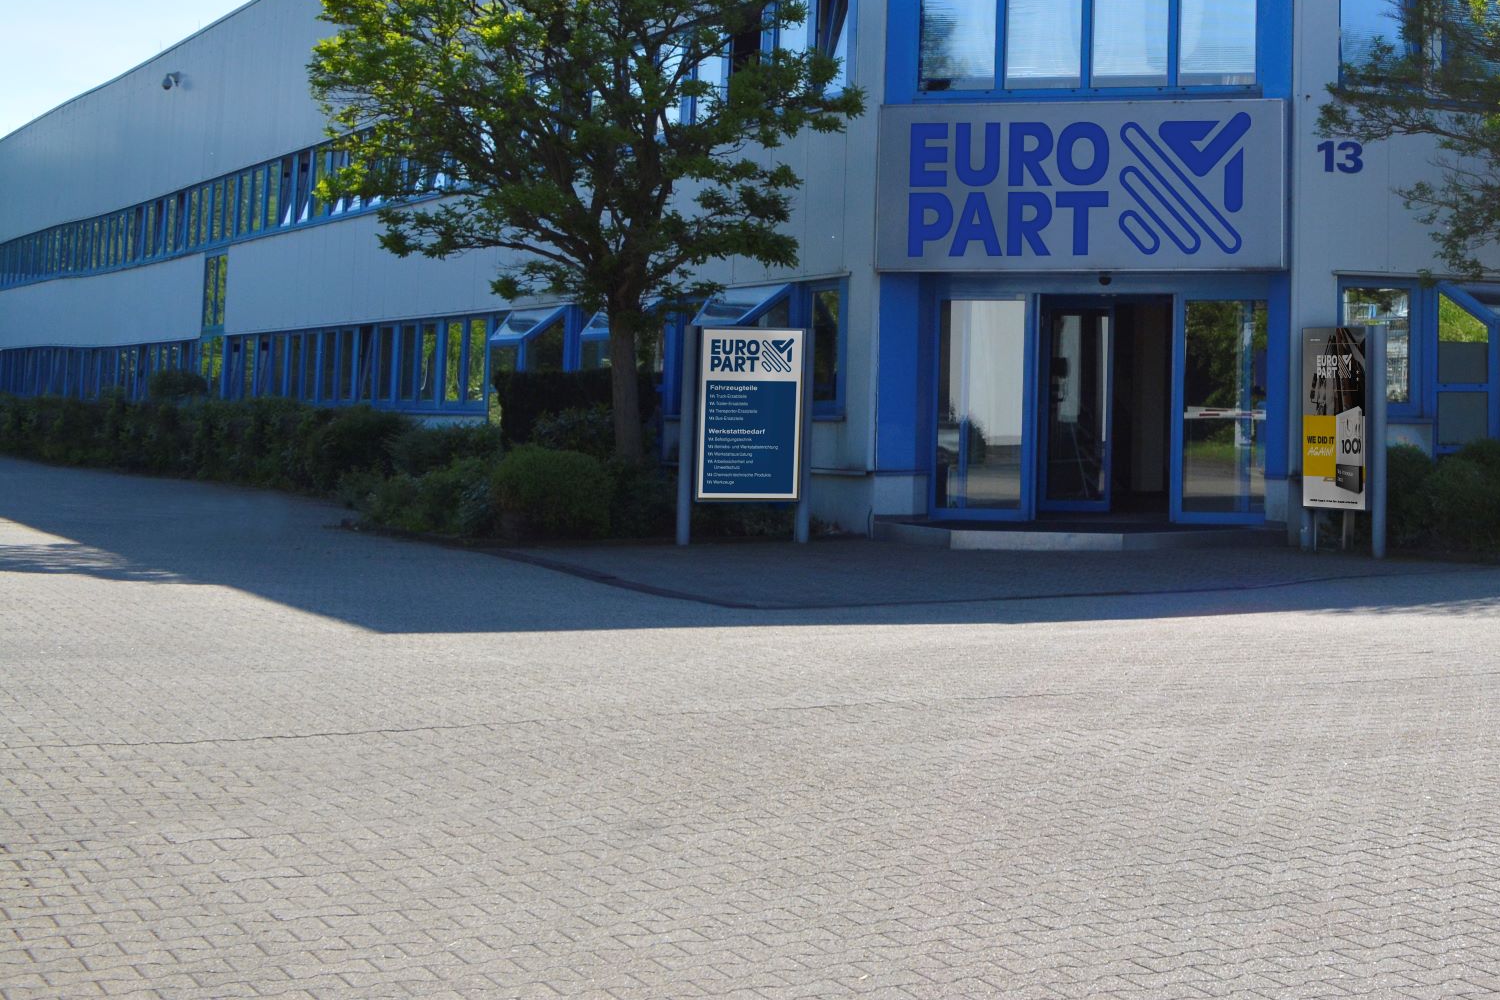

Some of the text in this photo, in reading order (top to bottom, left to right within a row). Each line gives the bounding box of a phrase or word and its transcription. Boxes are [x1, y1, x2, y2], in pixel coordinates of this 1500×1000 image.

[909, 121, 1110, 187] EURO
[1317, 140, 1364, 175] 13
[907, 190, 1109, 258] PART
[710, 339, 760, 356] EURO
[710, 356, 760, 373] PART
[1316, 354, 1338, 367] EURO
[1316, 366, 1338, 379] PART
[710, 384, 758, 392] Fahrzeugteile
[1307, 435, 1335, 445] WE DID IT
